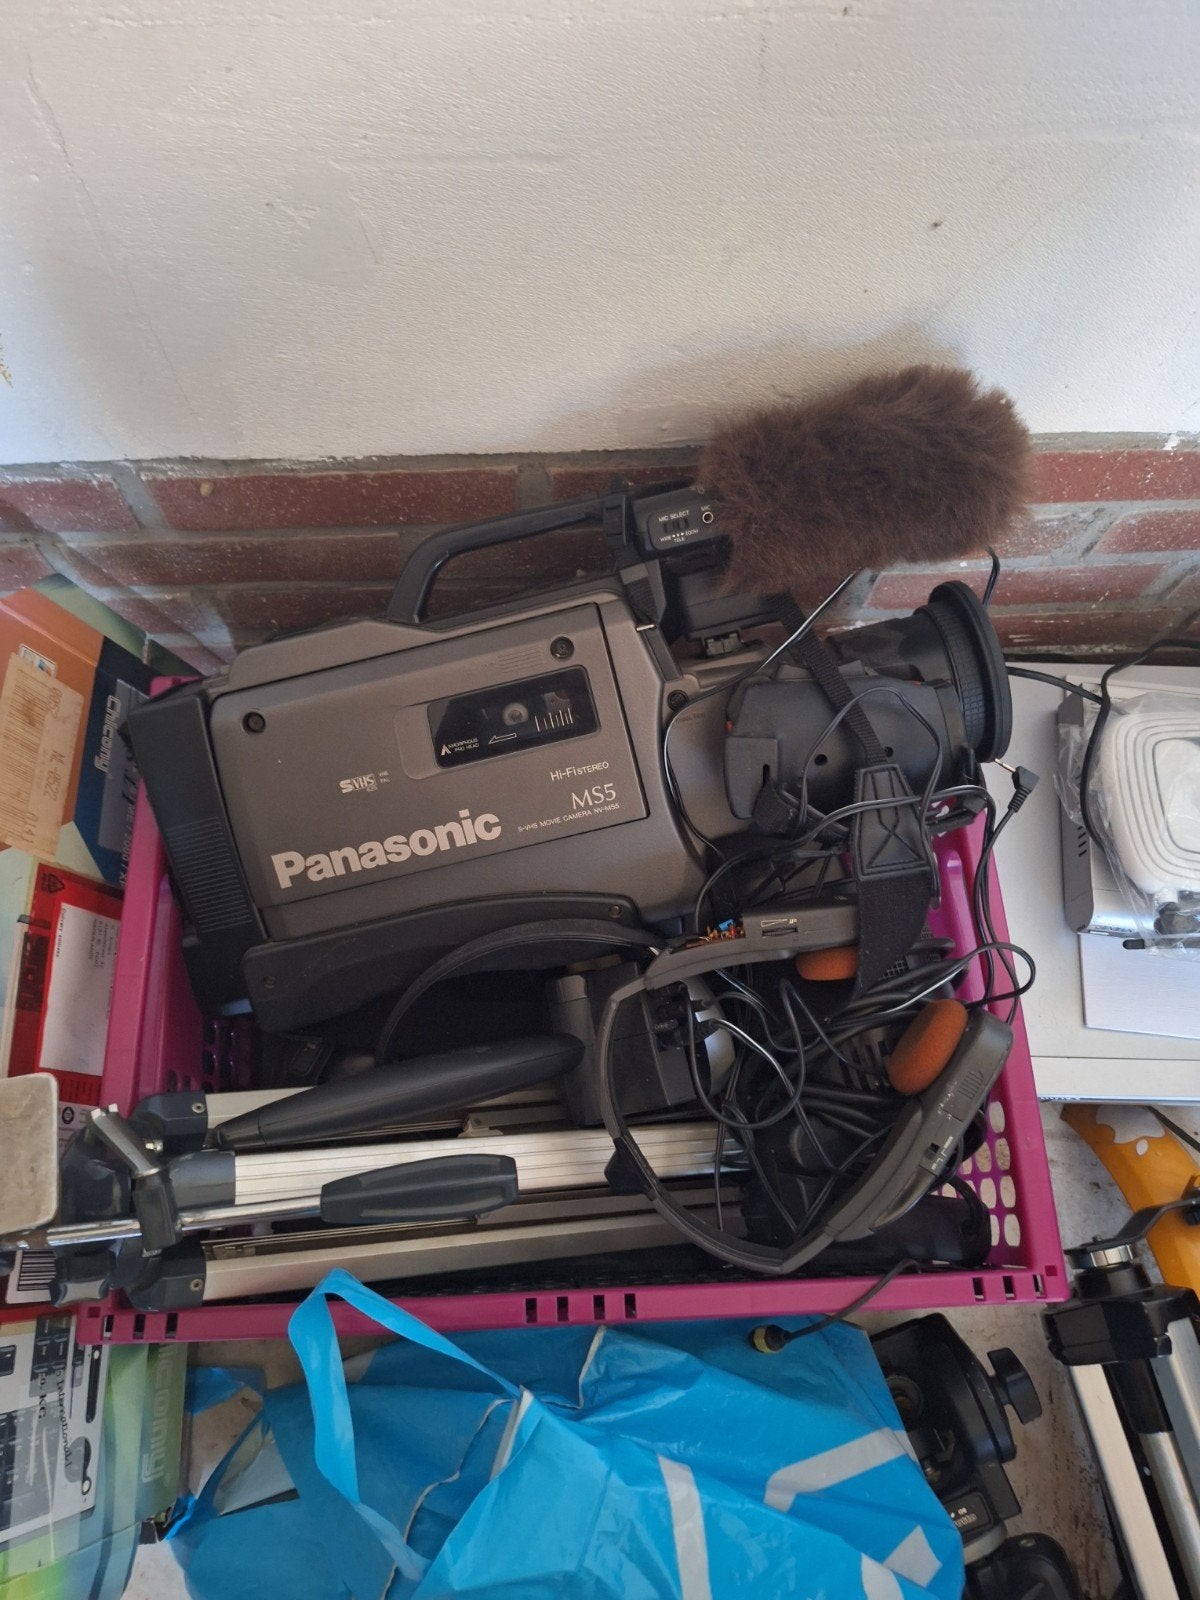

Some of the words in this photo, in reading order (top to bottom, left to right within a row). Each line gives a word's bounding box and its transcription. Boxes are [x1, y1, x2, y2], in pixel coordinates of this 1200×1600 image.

[94, 694, 122, 774] Chicony
[539, 816, 561, 827] MOVIE
[563, 810, 592, 822] CAMERA
[571, 783, 616, 810] MS5
[270, 809, 503, 890] Panasonic
